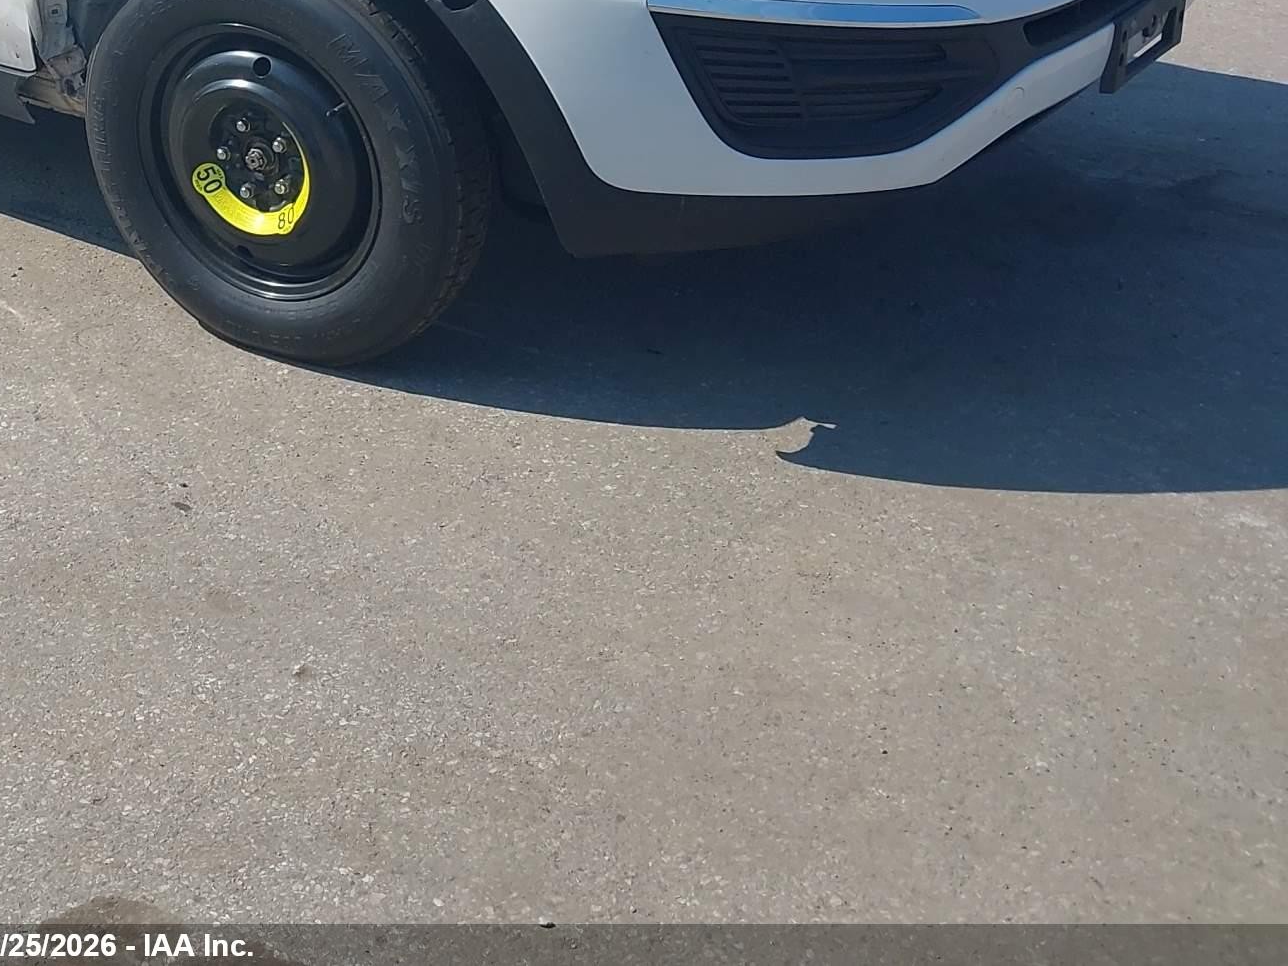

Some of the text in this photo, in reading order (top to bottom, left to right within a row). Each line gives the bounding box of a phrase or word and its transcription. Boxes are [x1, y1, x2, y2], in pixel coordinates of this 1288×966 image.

[327, 33, 421, 224] MAXXIS
[196, 166, 223, 194] 50
[277, 207, 295, 230] 80
